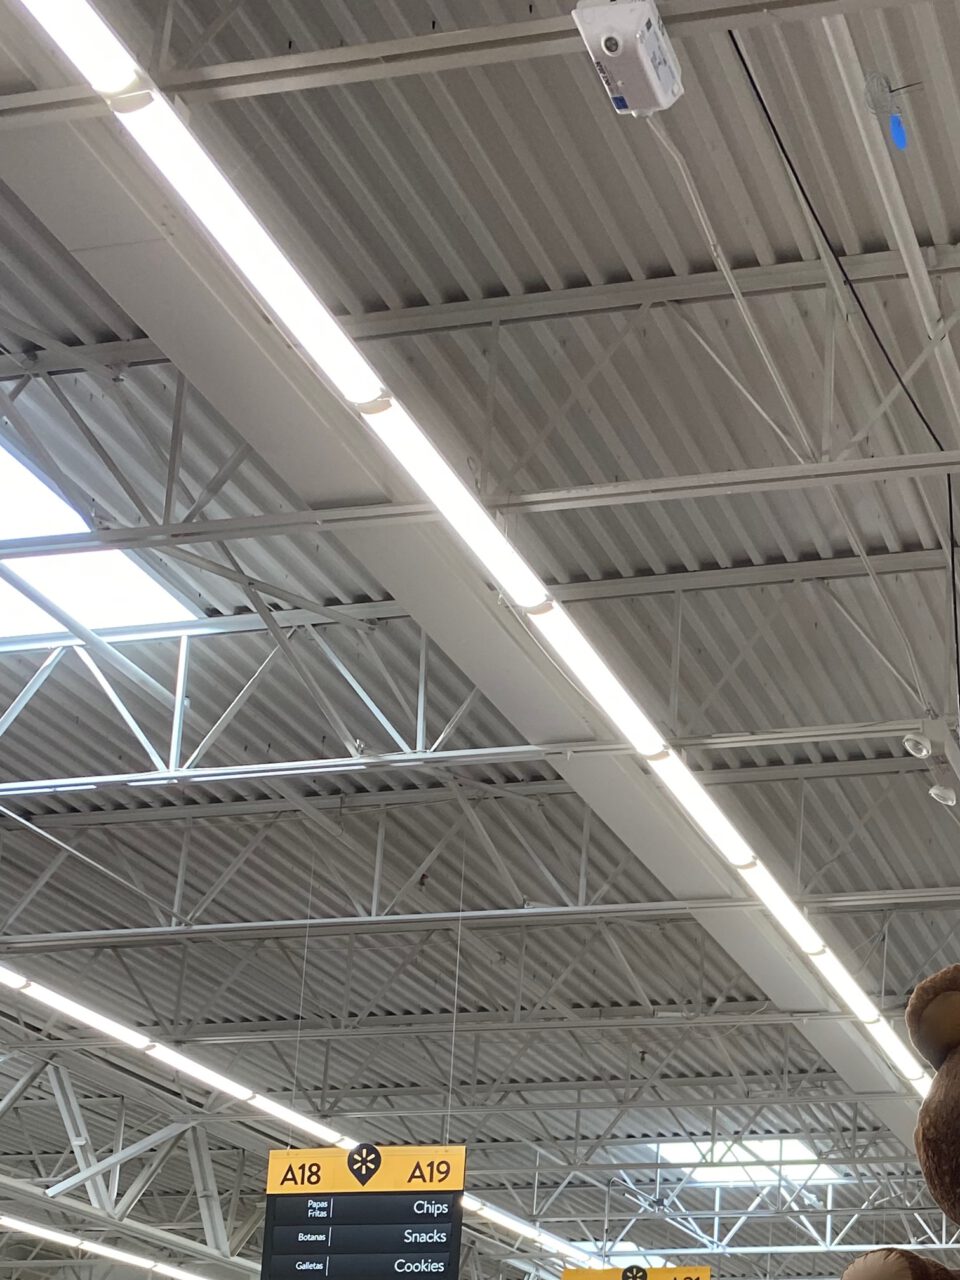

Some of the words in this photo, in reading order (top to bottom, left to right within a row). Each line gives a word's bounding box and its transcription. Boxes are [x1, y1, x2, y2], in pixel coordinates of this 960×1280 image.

[280, 1163, 321, 1186] A18
[407, 1160, 451, 1184] A19
[308, 1199, 328, 1211] Papas
[413, 1200, 448, 1217] Chips
[298, 1232, 326, 1241] Botanas
[404, 1229, 446, 1243] Snacks
[295, 1261, 323, 1270] Galletas
[394, 1259, 444, 1273] Cookies
